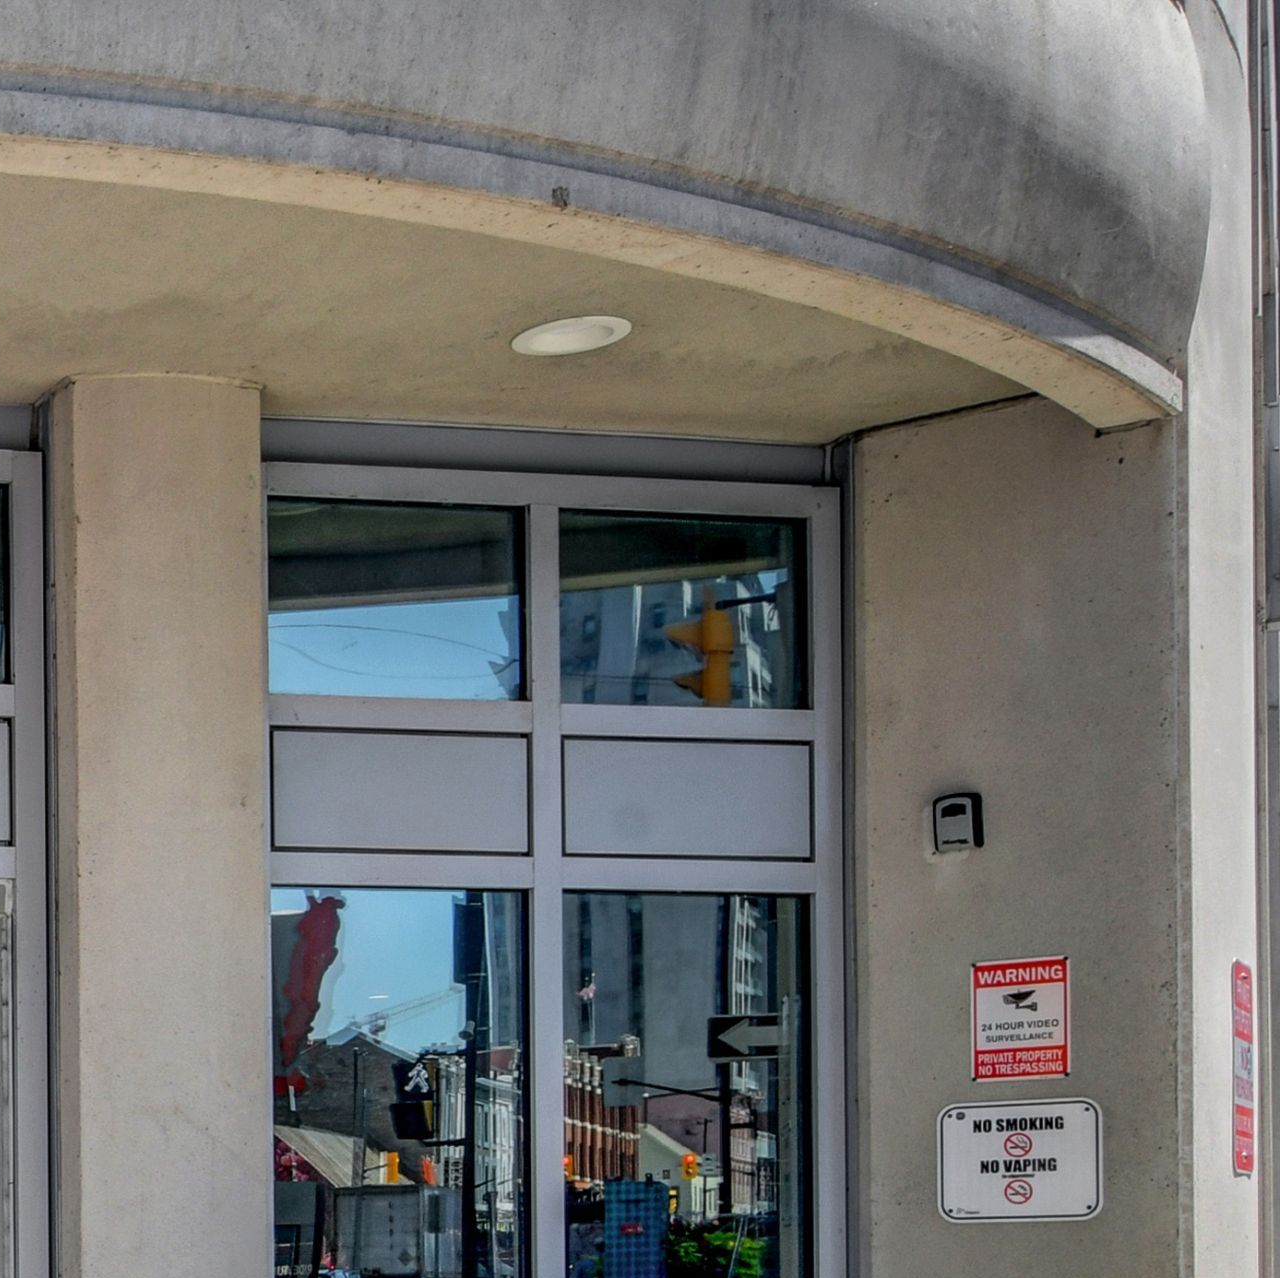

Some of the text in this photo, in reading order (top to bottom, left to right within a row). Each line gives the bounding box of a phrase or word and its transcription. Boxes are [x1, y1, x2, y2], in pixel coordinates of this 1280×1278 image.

[977, 965, 1063, 985] WARNING
[981, 1019, 1059, 1032] 24 HOUR VIDEO
[985, 1032, 1054, 1043] SURVEILLANCE
[978, 1049, 1063, 1064] PRIVATE PROPERTY
[979, 1061, 1063, 1076] NO TRESPASSING
[973, 1116, 1064, 1133] NO SMOKING
[980, 1157, 1057, 1174] NO VAPING
